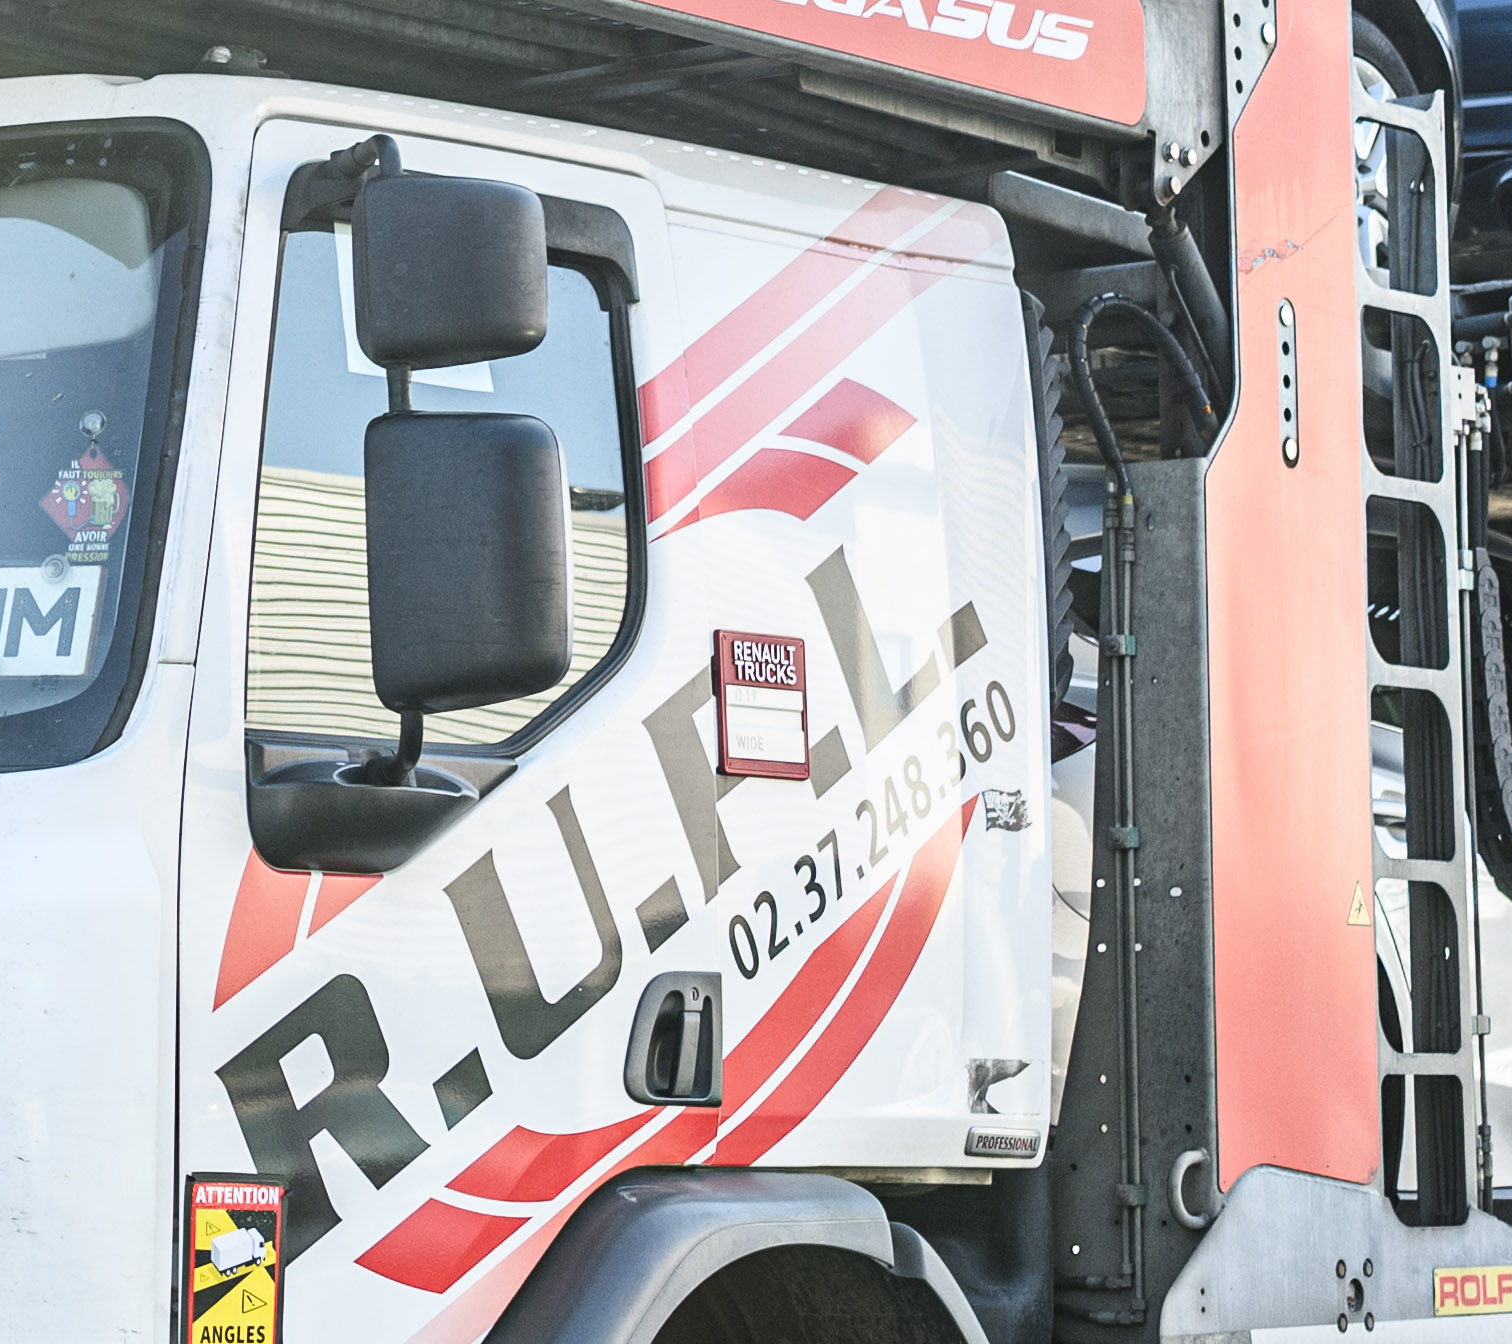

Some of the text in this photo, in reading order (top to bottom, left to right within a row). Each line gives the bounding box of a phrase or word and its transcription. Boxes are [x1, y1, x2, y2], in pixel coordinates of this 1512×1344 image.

[58, 470, 81, 479] FAUT
[74, 531, 107, 543] AVOIR
[733, 640, 795, 666] RENAULT
[734, 660, 797, 685] TRUCKS
[736, 735, 765, 750] WIDE
[729, 681, 1015, 979] 02.37.248.360
[975, 1135, 1038, 1151] PROFESSIONAL
[195, 1185, 280, 1205] ATTENTION
[200, 1325, 265, 1344] ANGLES
